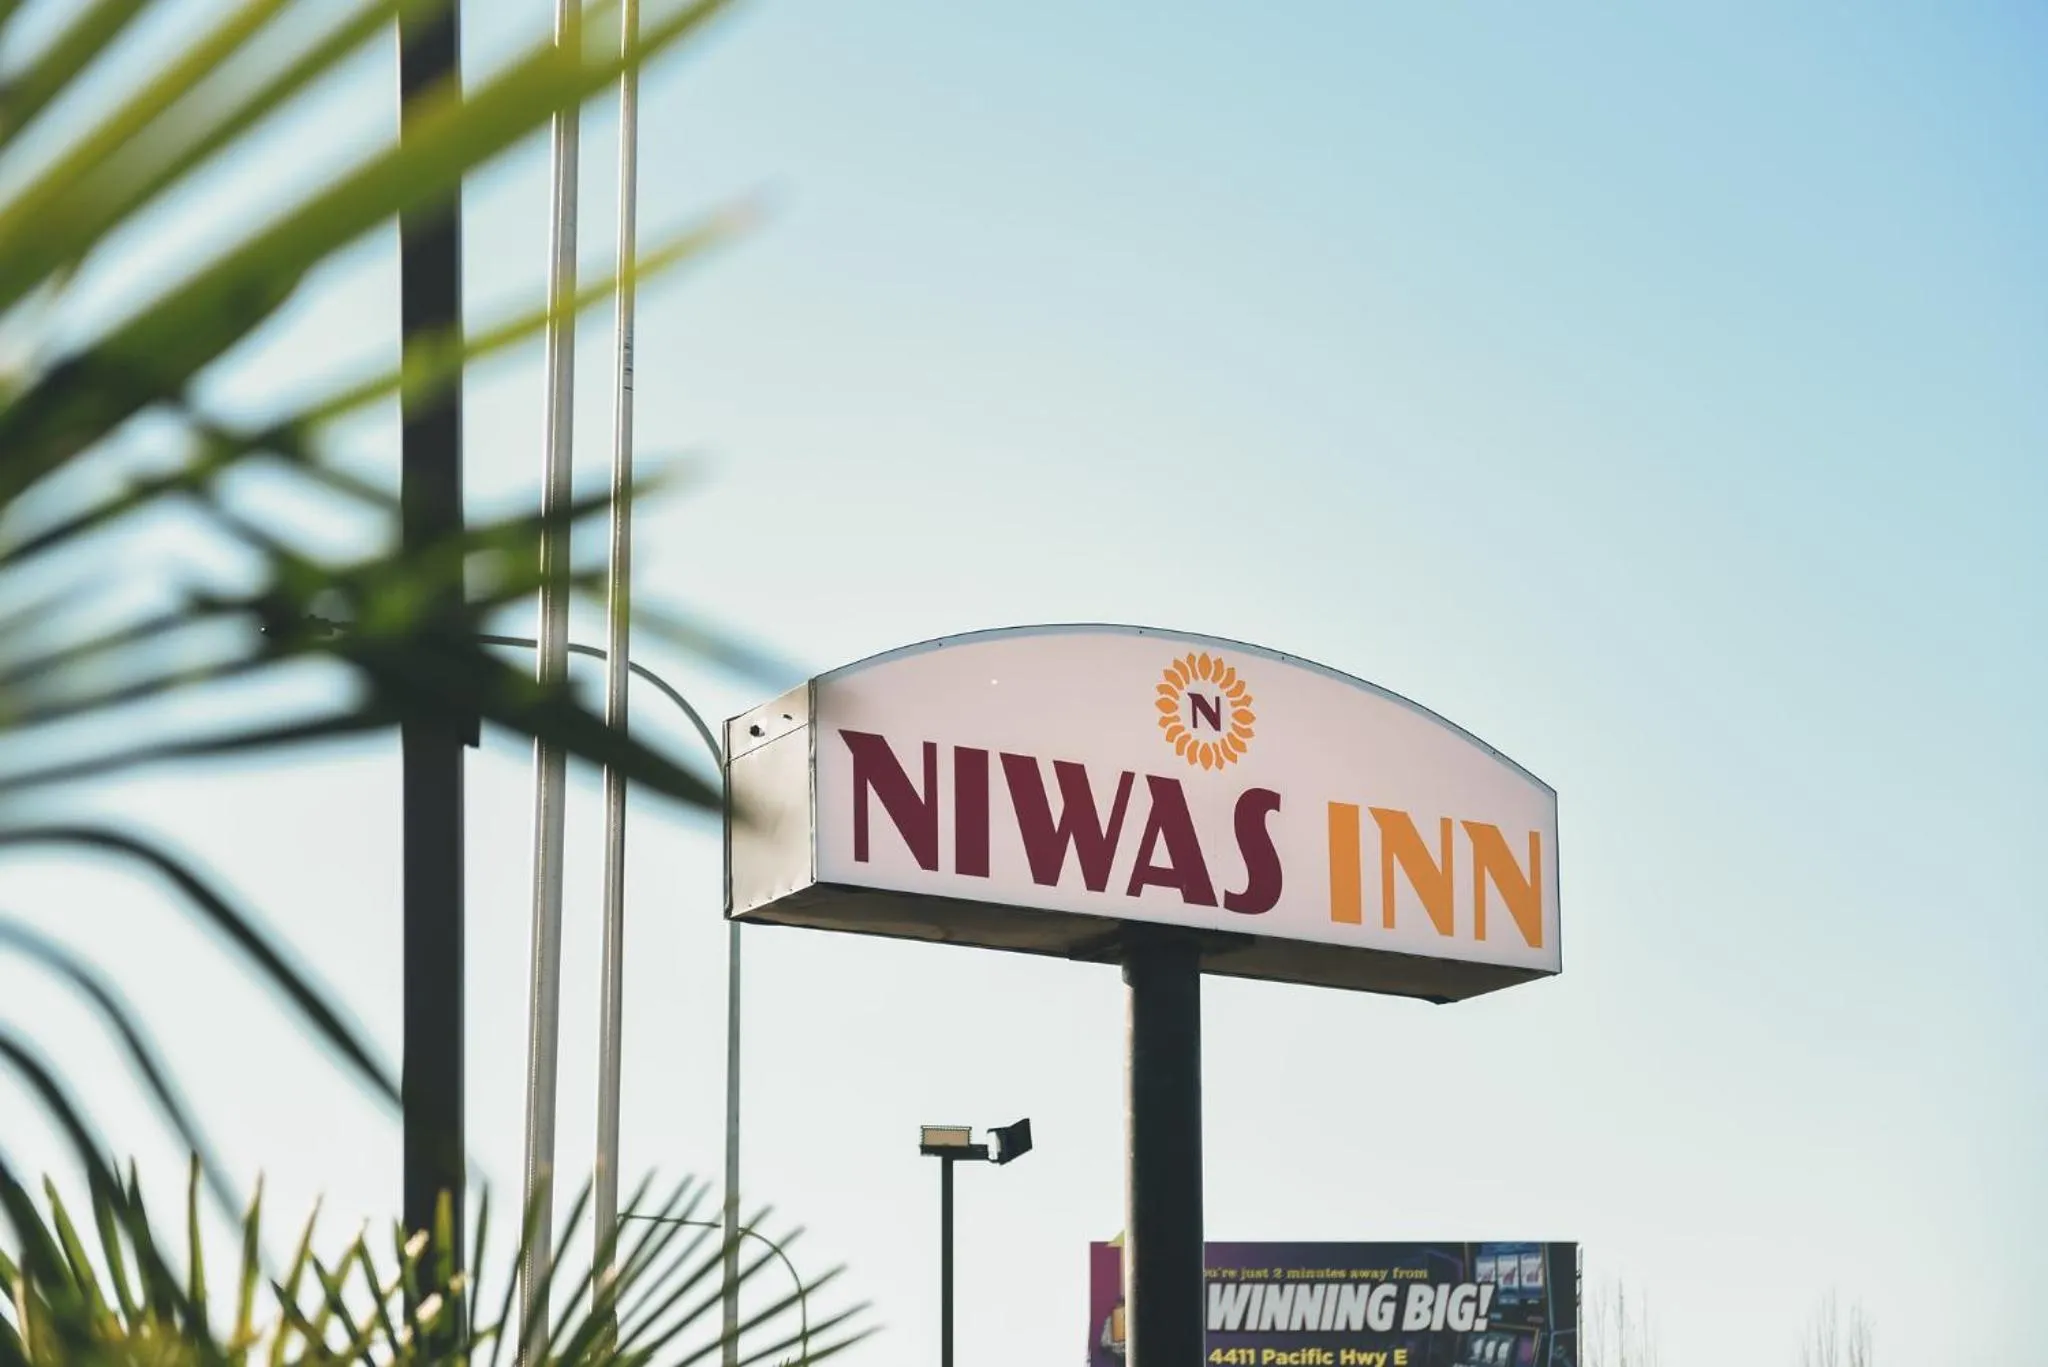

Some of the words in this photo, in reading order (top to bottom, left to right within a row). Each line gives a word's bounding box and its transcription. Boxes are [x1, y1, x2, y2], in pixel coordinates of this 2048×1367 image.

[1187, 692, 1222, 732] N
[838, 729, 1283, 916] NIWAS
[1327, 801, 1543, 949] INN
[1240, 1267, 1268, 1280] just
[1272, 1267, 1282, 1278] 2
[1286, 1267, 1346, 1279] minutes
[1350, 1268, 1388, 1281] away
[1392, 1267, 1428, 1279] from
[1206, 1282, 1398, 1332] WINNING
[1401, 1282, 1496, 1332] BIG!
[1208, 1348, 1256, 1365] 4411
[1261, 1347, 1334, 1366] Pacific
[1339, 1348, 1388, 1367] Hwy
[1393, 1348, 1408, 1366] E
